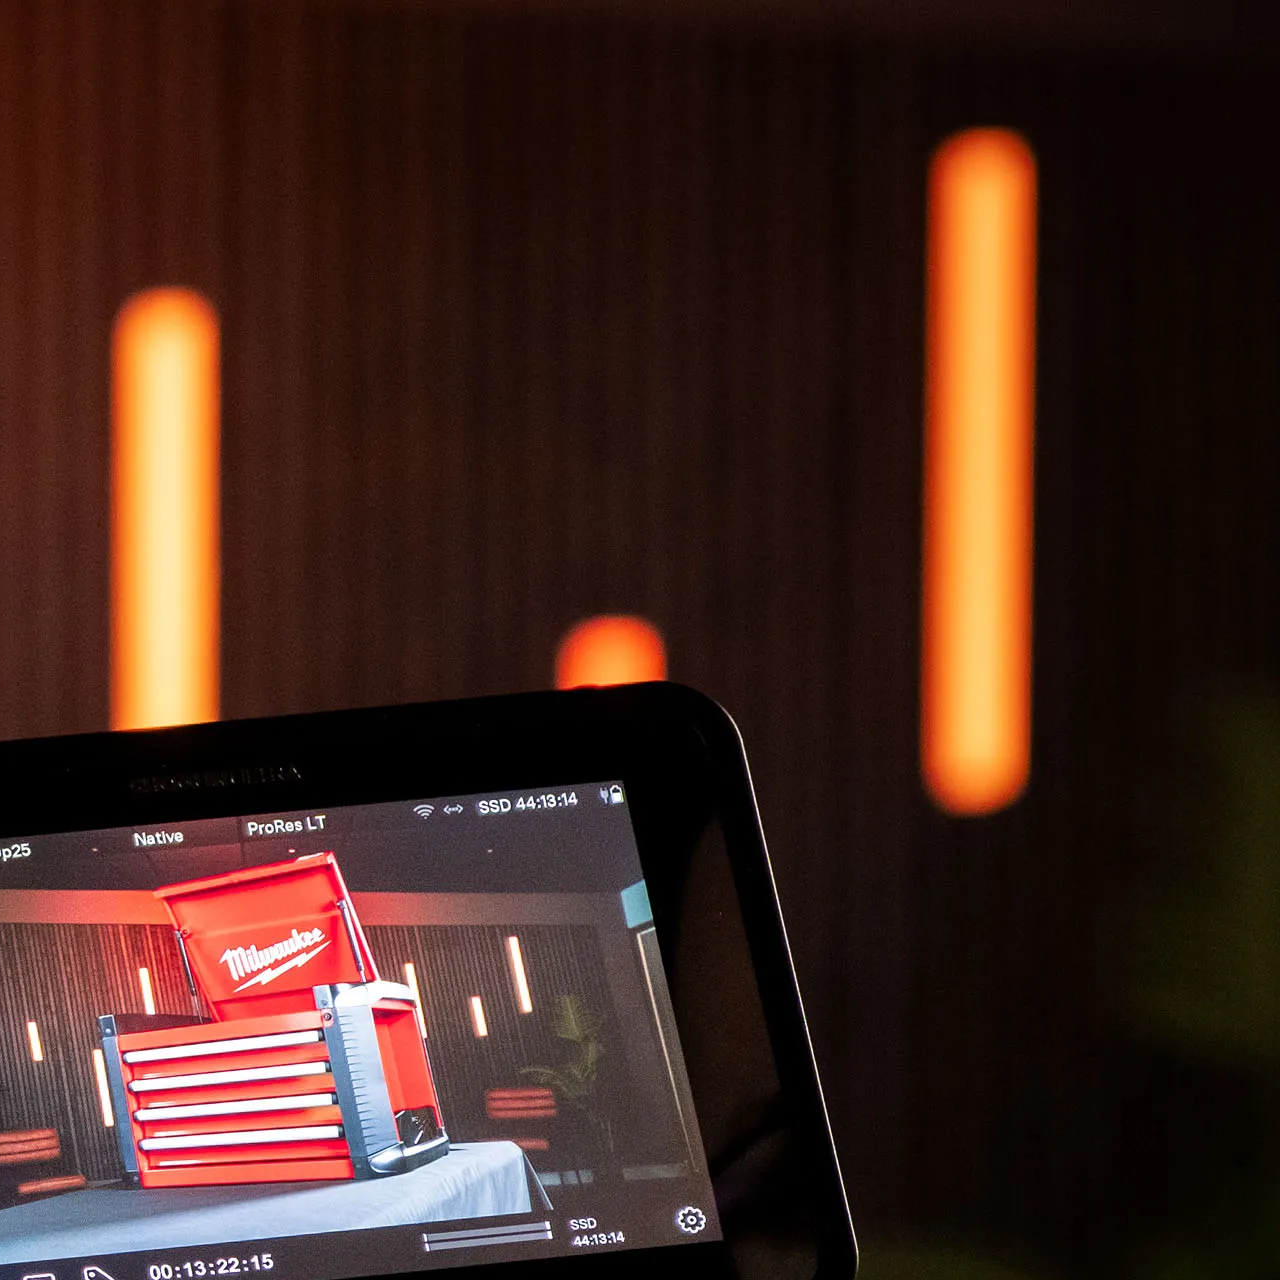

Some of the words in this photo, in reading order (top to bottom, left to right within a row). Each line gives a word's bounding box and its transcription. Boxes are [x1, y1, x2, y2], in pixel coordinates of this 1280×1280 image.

[478, 798, 512, 815] SSD
[515, 791, 578, 811] 44:13:14
[246, 818, 303, 836] ProRes
[306, 815, 326, 831] LT
[133, 830, 184, 847] Native
[219, 927, 326, 982] Milwaukee
[569, 1217, 597, 1231] SSD
[573, 1231, 626, 1248] 44:13:14
[149, 1253, 274, 1280] 00:13:22:15
